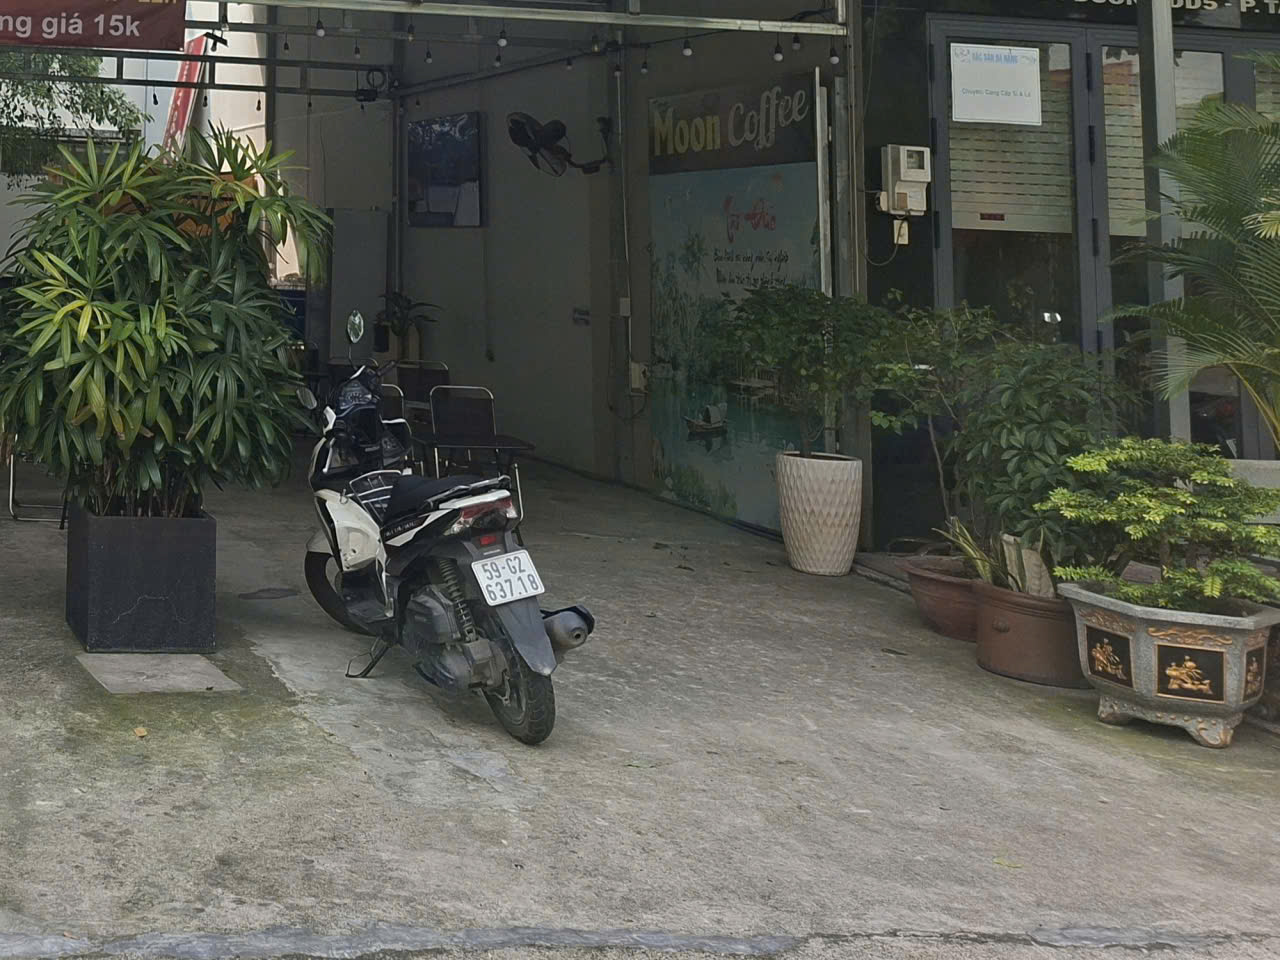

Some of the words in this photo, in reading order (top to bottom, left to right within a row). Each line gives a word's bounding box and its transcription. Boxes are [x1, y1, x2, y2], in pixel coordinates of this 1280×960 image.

[1264, 0, 1280, 14] T
[42, 11, 83, 41] giá
[93, 14, 141, 37] 15k
[654, 106, 720, 156] Moon
[728, 85, 809, 152] Coffee
[481, 556, 526, 581] 59-G2
[485, 574, 539, 602] 637.18
